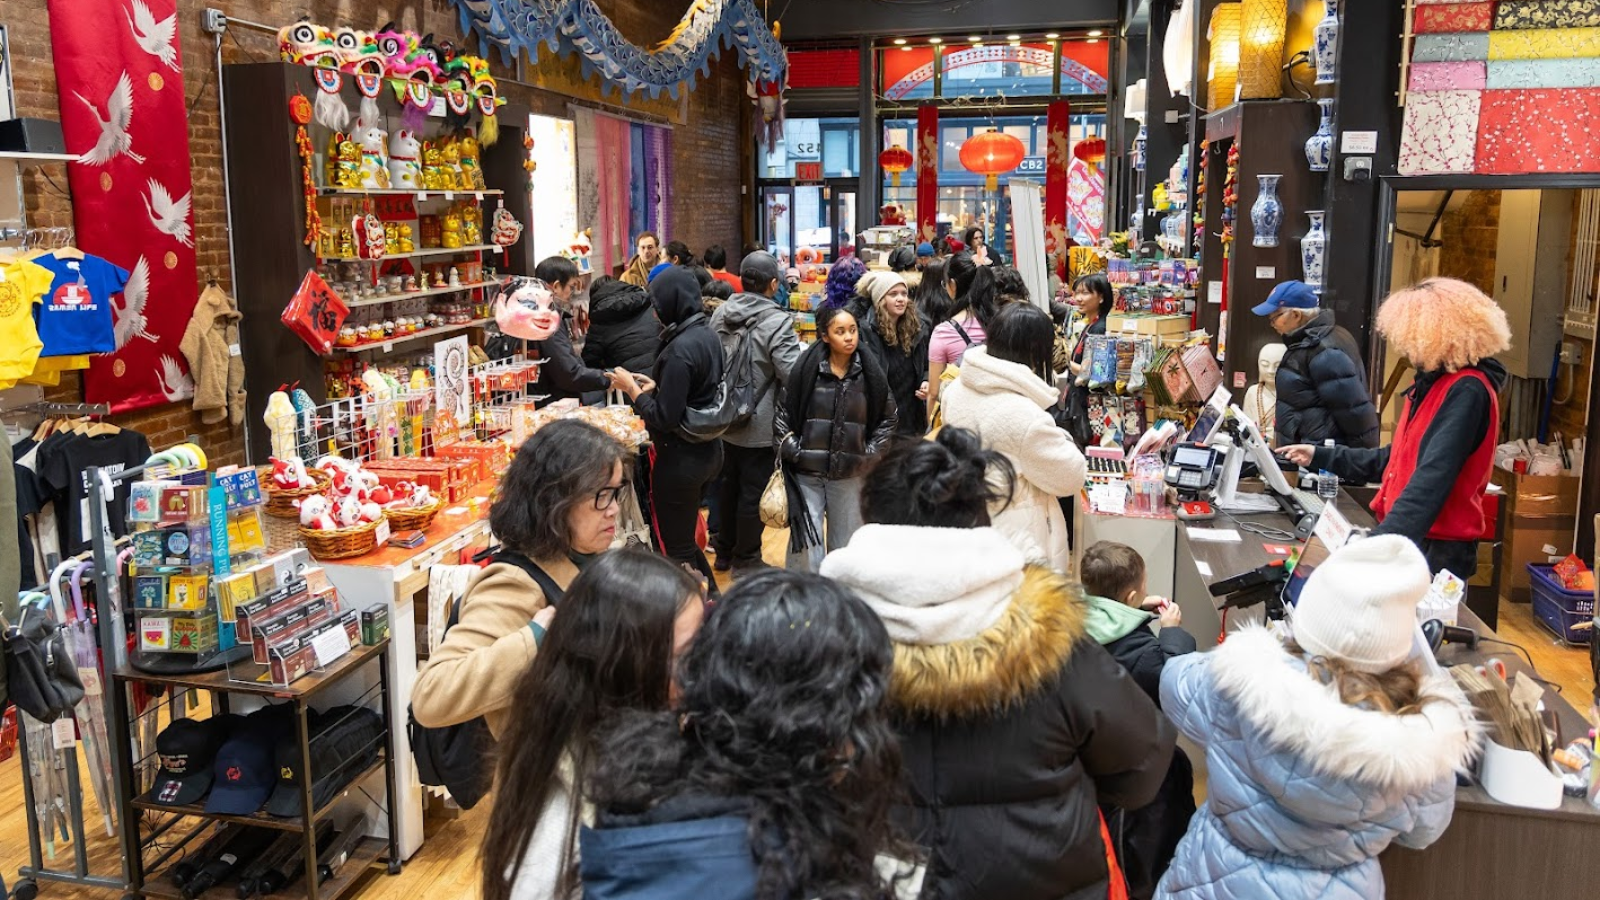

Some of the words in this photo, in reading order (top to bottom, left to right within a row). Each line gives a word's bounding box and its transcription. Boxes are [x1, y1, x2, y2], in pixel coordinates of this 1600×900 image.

[798, 164, 820, 180] EXIT
[1019, 160, 1043, 170] CB2
[308, 290, 337, 332] 福
[219, 476, 234, 486] CAT
[239, 472, 252, 481] CAT
[239, 479, 256, 491] PULT
[213, 504, 227, 557] RUNNING
[219, 559, 229, 575] PR
